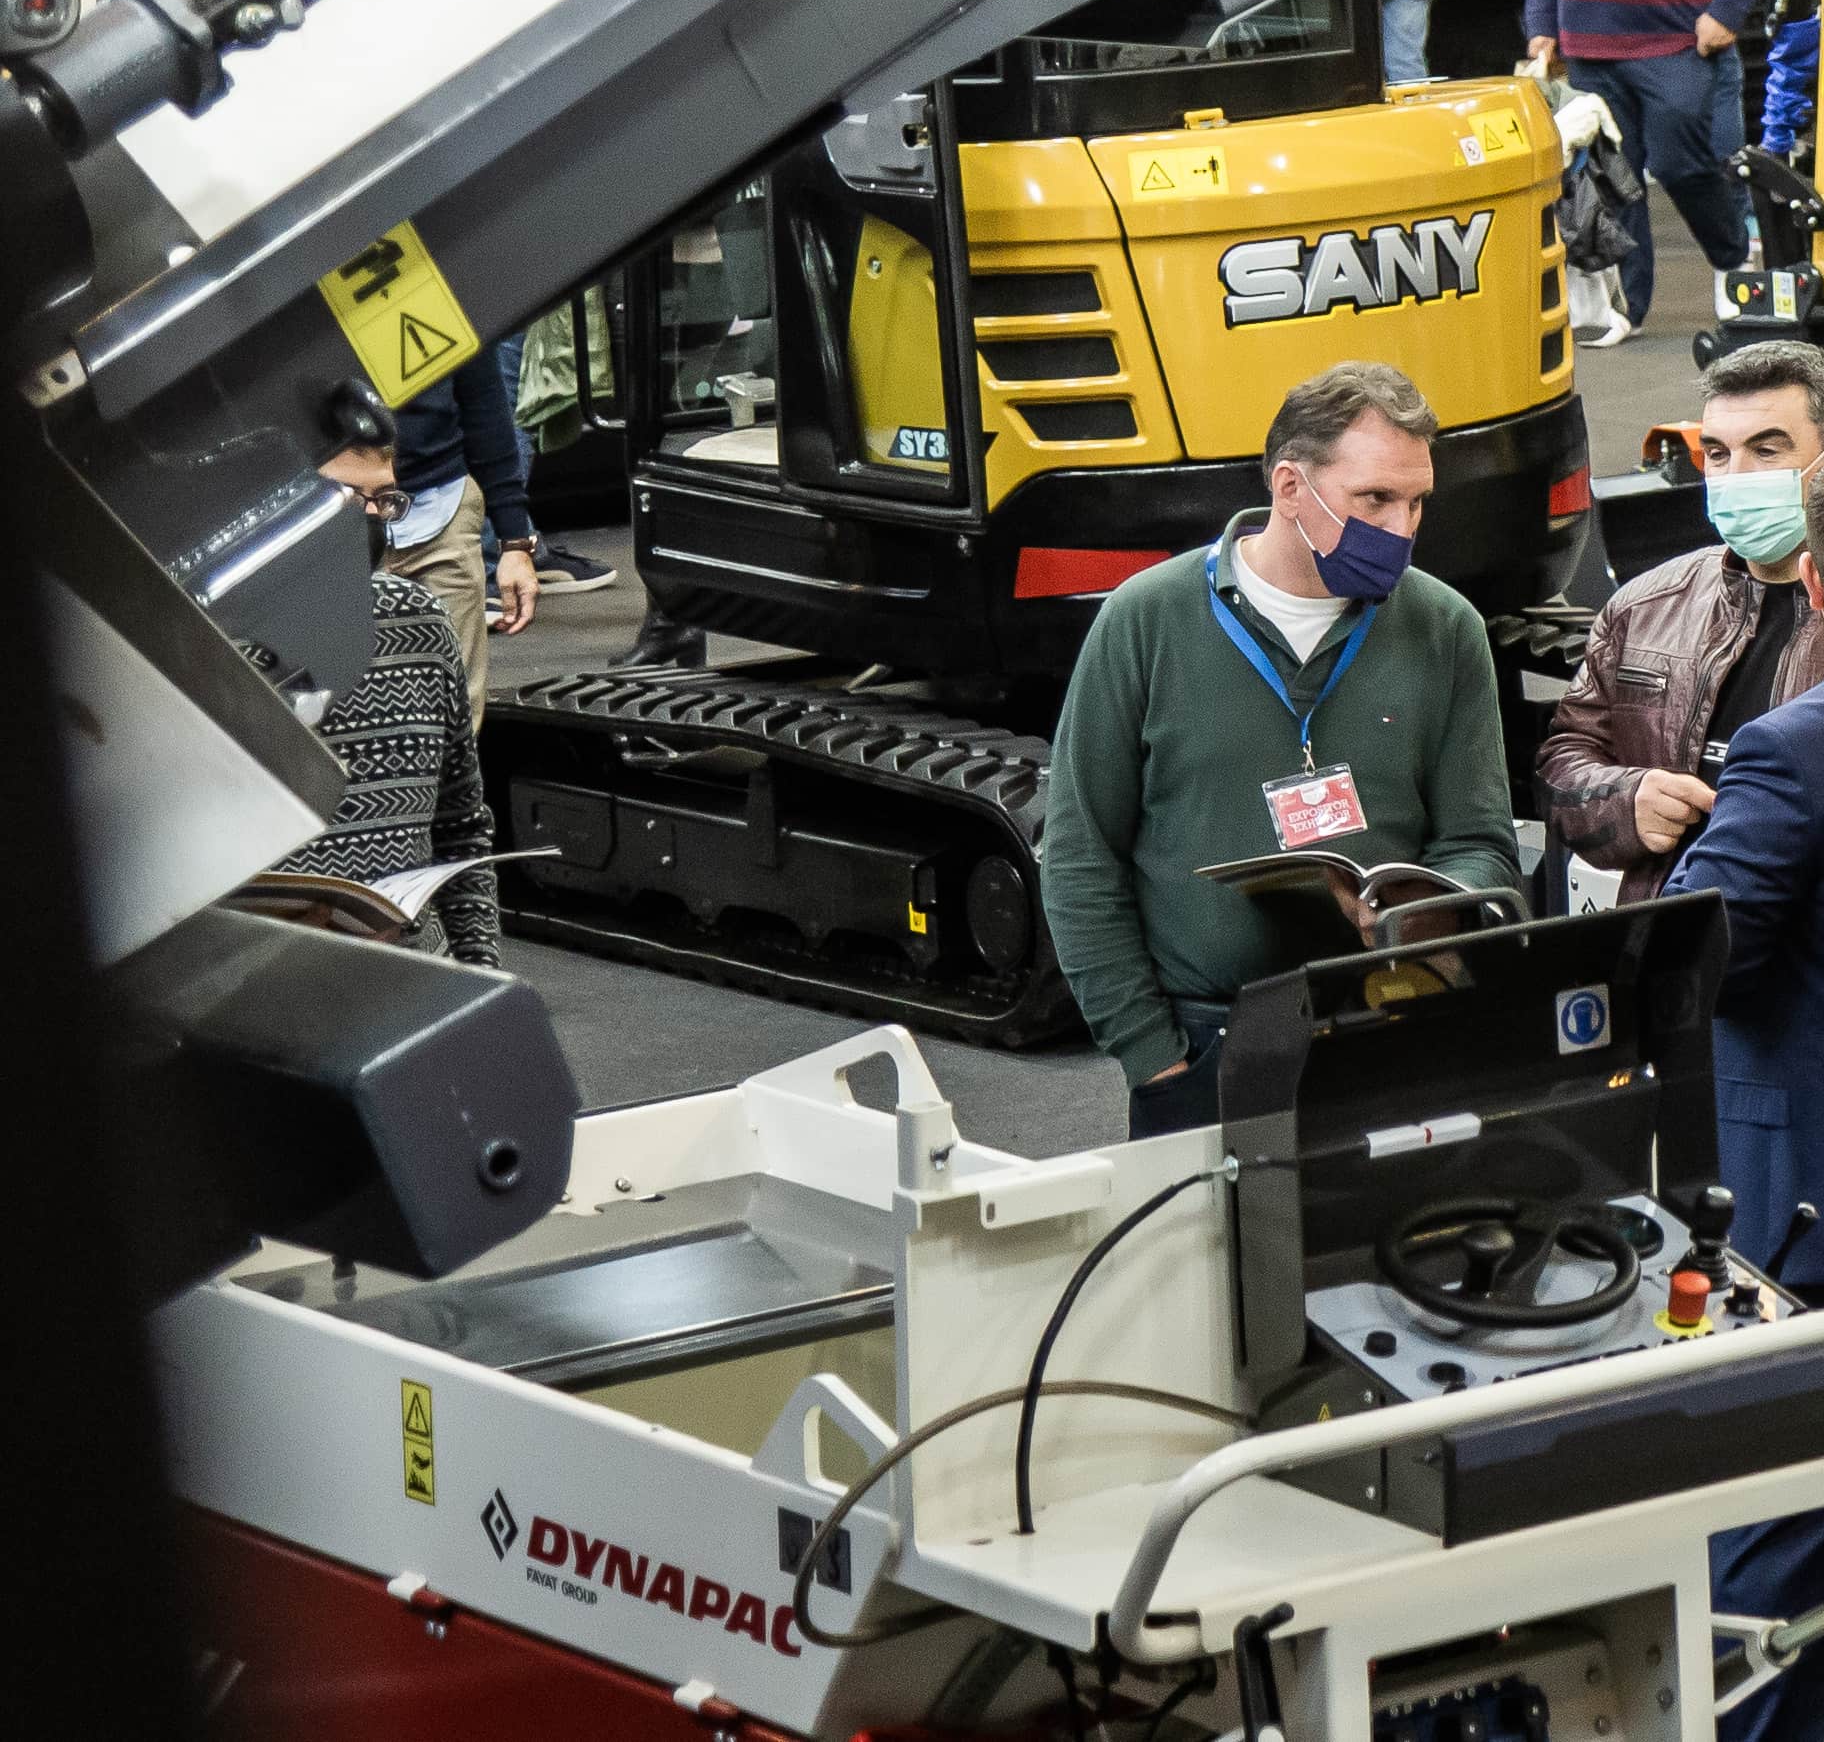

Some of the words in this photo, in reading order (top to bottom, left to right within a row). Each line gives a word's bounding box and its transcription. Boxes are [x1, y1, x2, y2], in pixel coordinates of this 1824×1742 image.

[1218, 209, 1495, 330] SANY
[899, 428, 949, 458] SY3
[526, 1566, 558, 1593] FAYAT
[561, 1580, 598, 1607] GROUP
[526, 1515, 802, 1659] DYNAPAC
